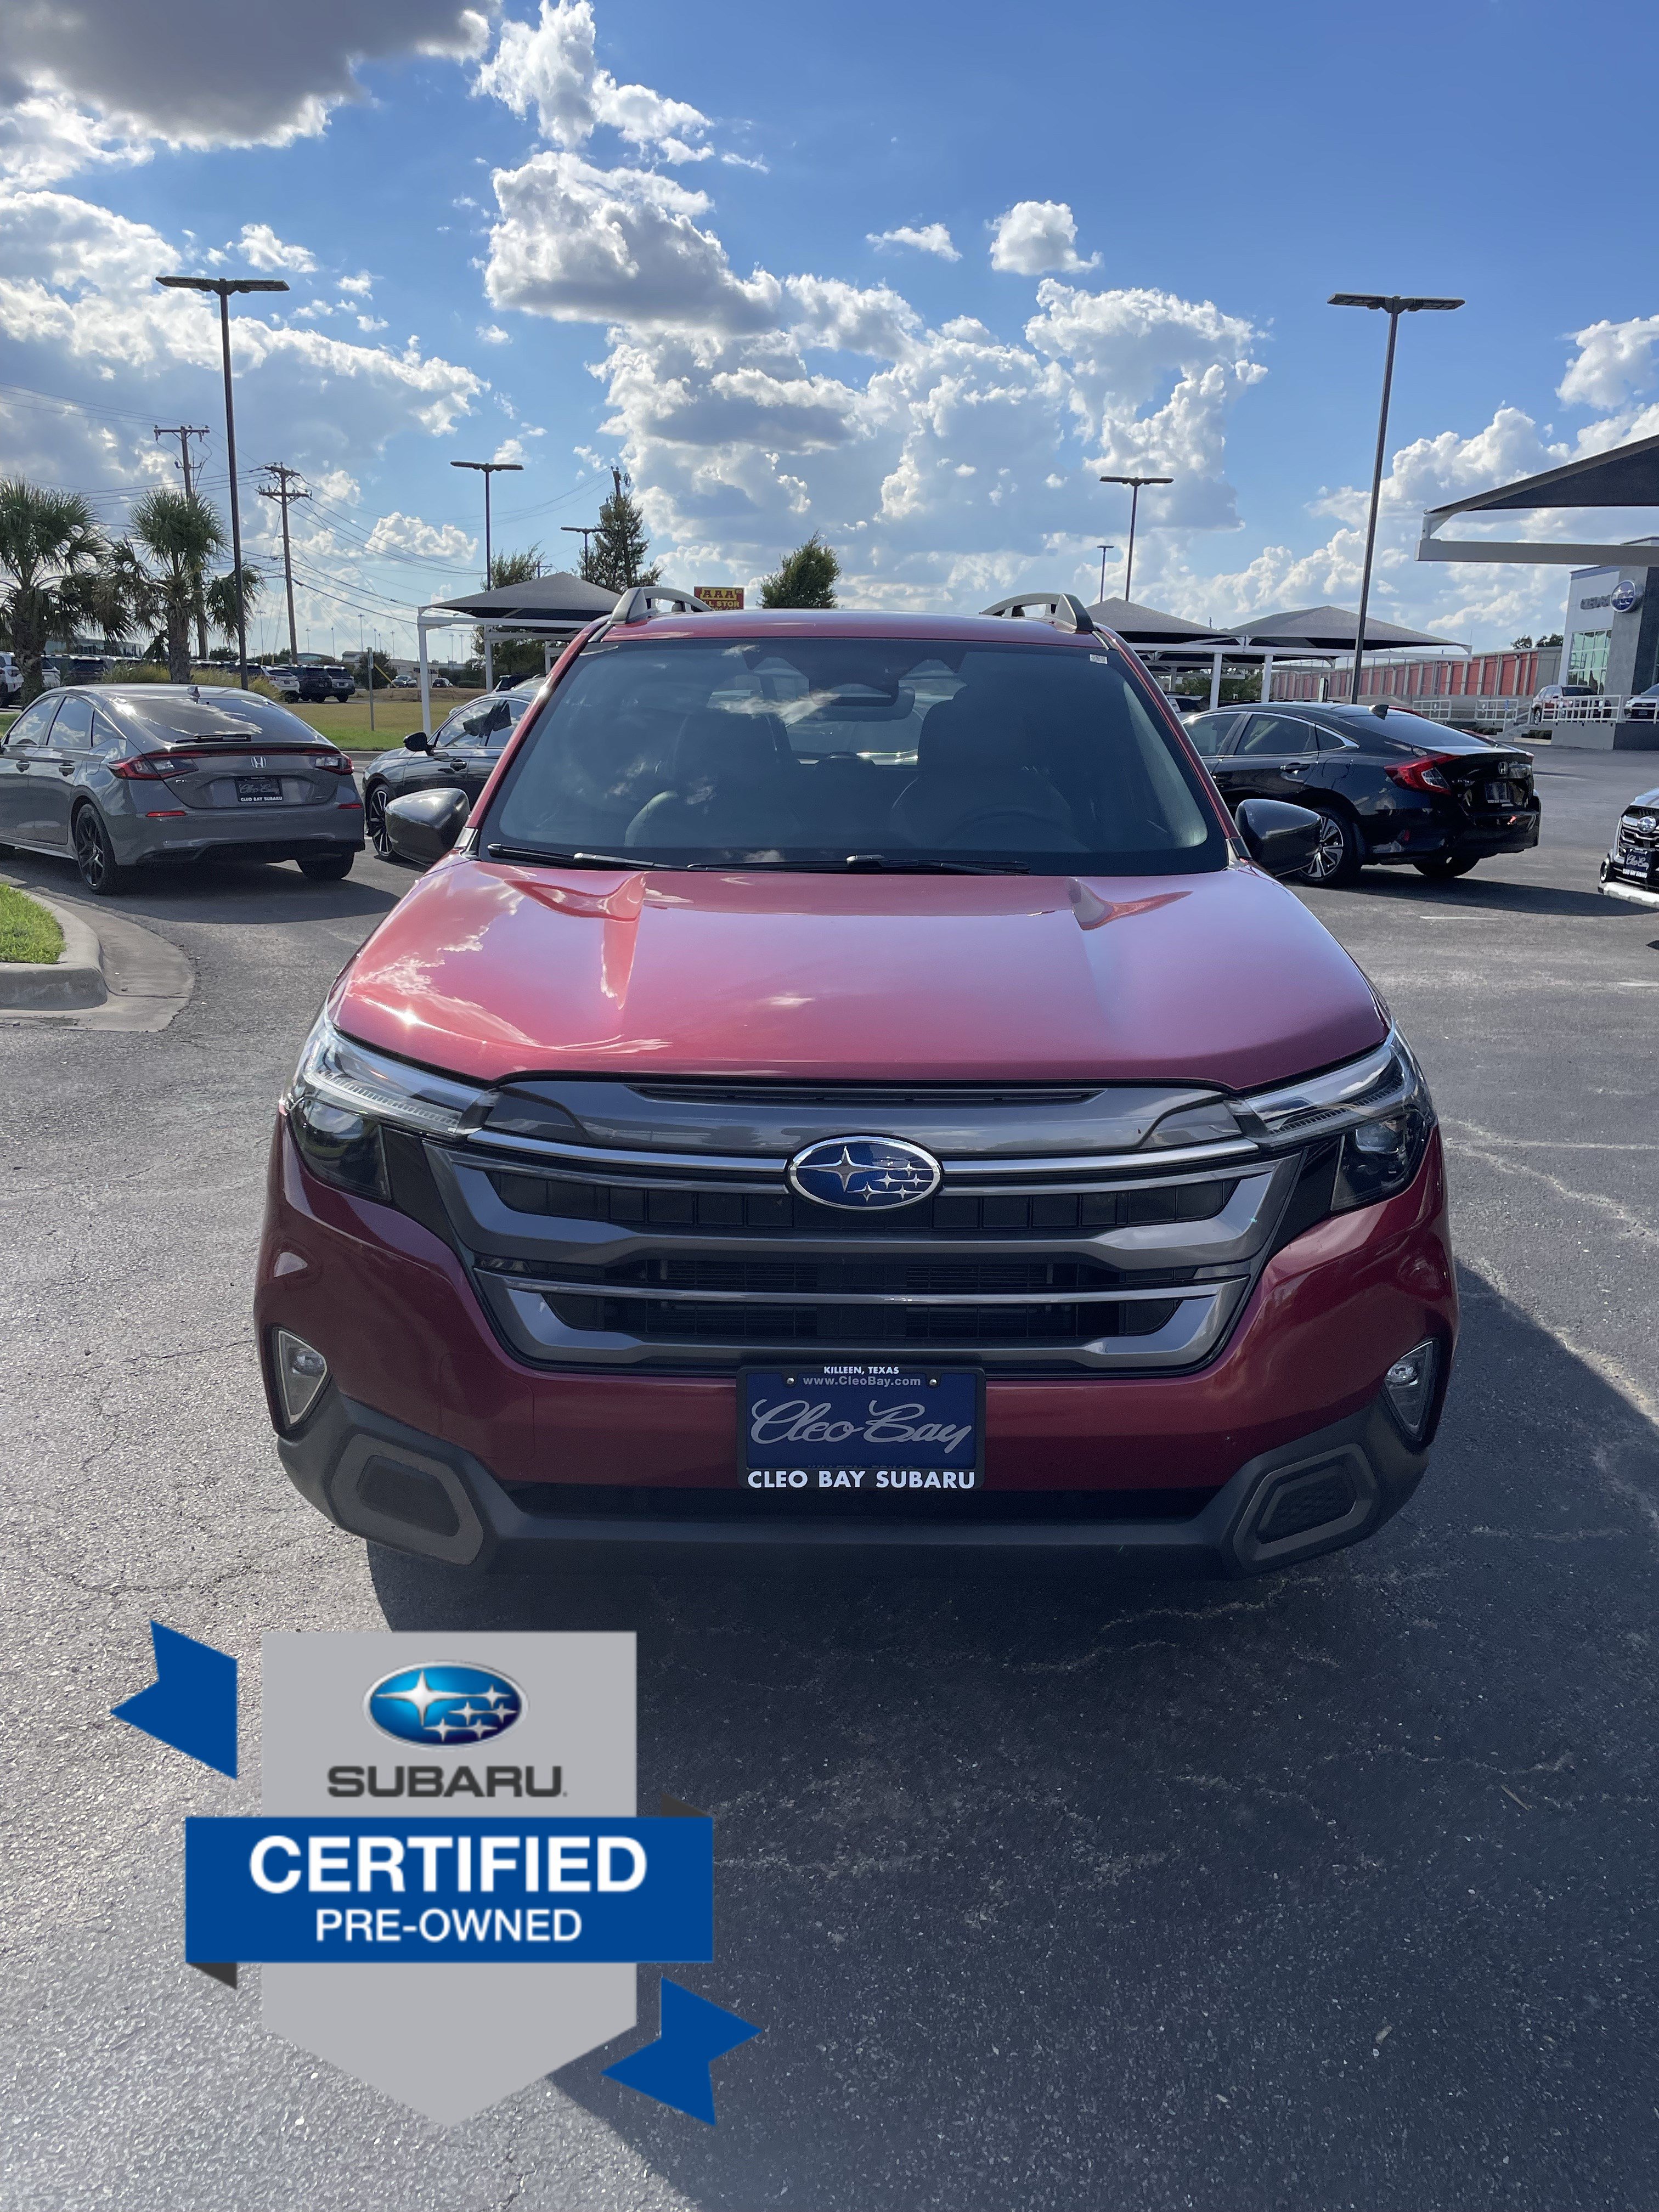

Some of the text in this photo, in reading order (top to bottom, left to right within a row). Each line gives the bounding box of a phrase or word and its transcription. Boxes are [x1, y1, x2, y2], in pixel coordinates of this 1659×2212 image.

[702, 590, 735, 598] AAA
[823, 1366, 899, 1375] KILLEEN, TEXAS
[803, 1376, 921, 1387] www.CleoBay.com
[751, 1398, 972, 1454] Cleo Bay
[748, 1470, 975, 1489] CLEO BAY SUBARU
